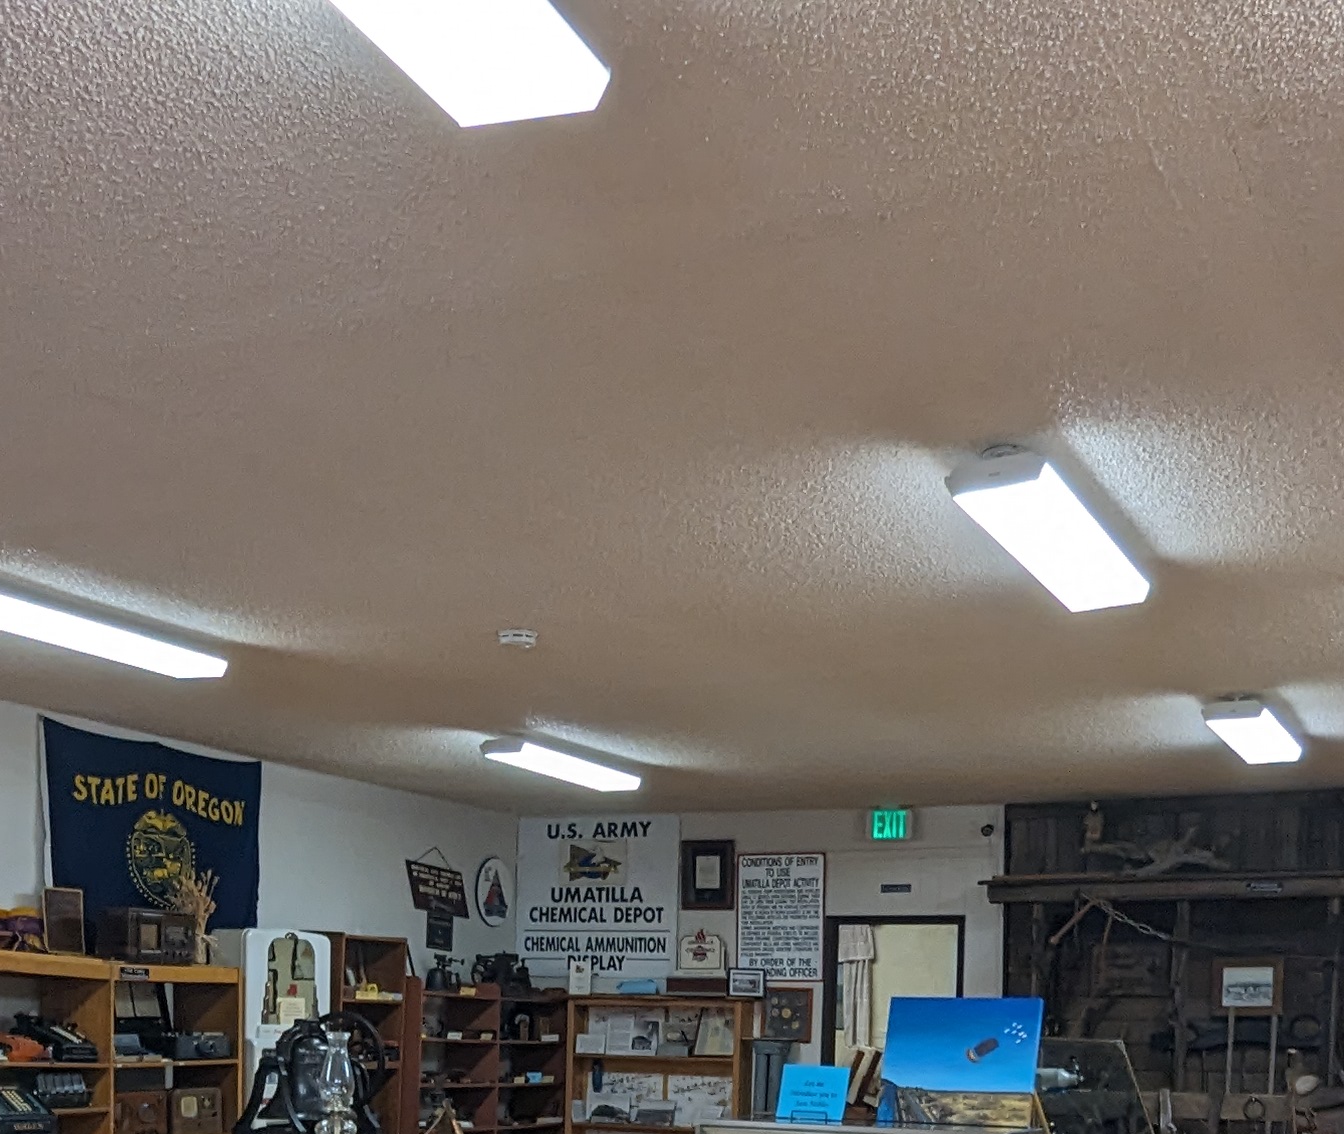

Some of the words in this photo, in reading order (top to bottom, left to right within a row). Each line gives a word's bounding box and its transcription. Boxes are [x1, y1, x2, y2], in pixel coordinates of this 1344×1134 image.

[72, 773, 139, 805] STATE
[144, 773, 167, 799] OF
[172, 780, 247, 826] OREGON
[547, 823, 583, 839] U.S.
[592, 821, 652, 839] ARMY
[873, 810, 907, 839] EXIT
[784, 857, 795, 867] OF
[550, 886, 644, 904] UMATILLA
[529, 906, 607, 924] CHEMICAL
[613, 906, 664, 924] DEPOT
[524, 936, 581, 952] CHEMICAL
[585, 936, 667, 953] AMMUNITION
[748, 958, 758, 967] BY
[786, 958, 796, 967] OF
[788, 968, 818, 978] OFFICER
